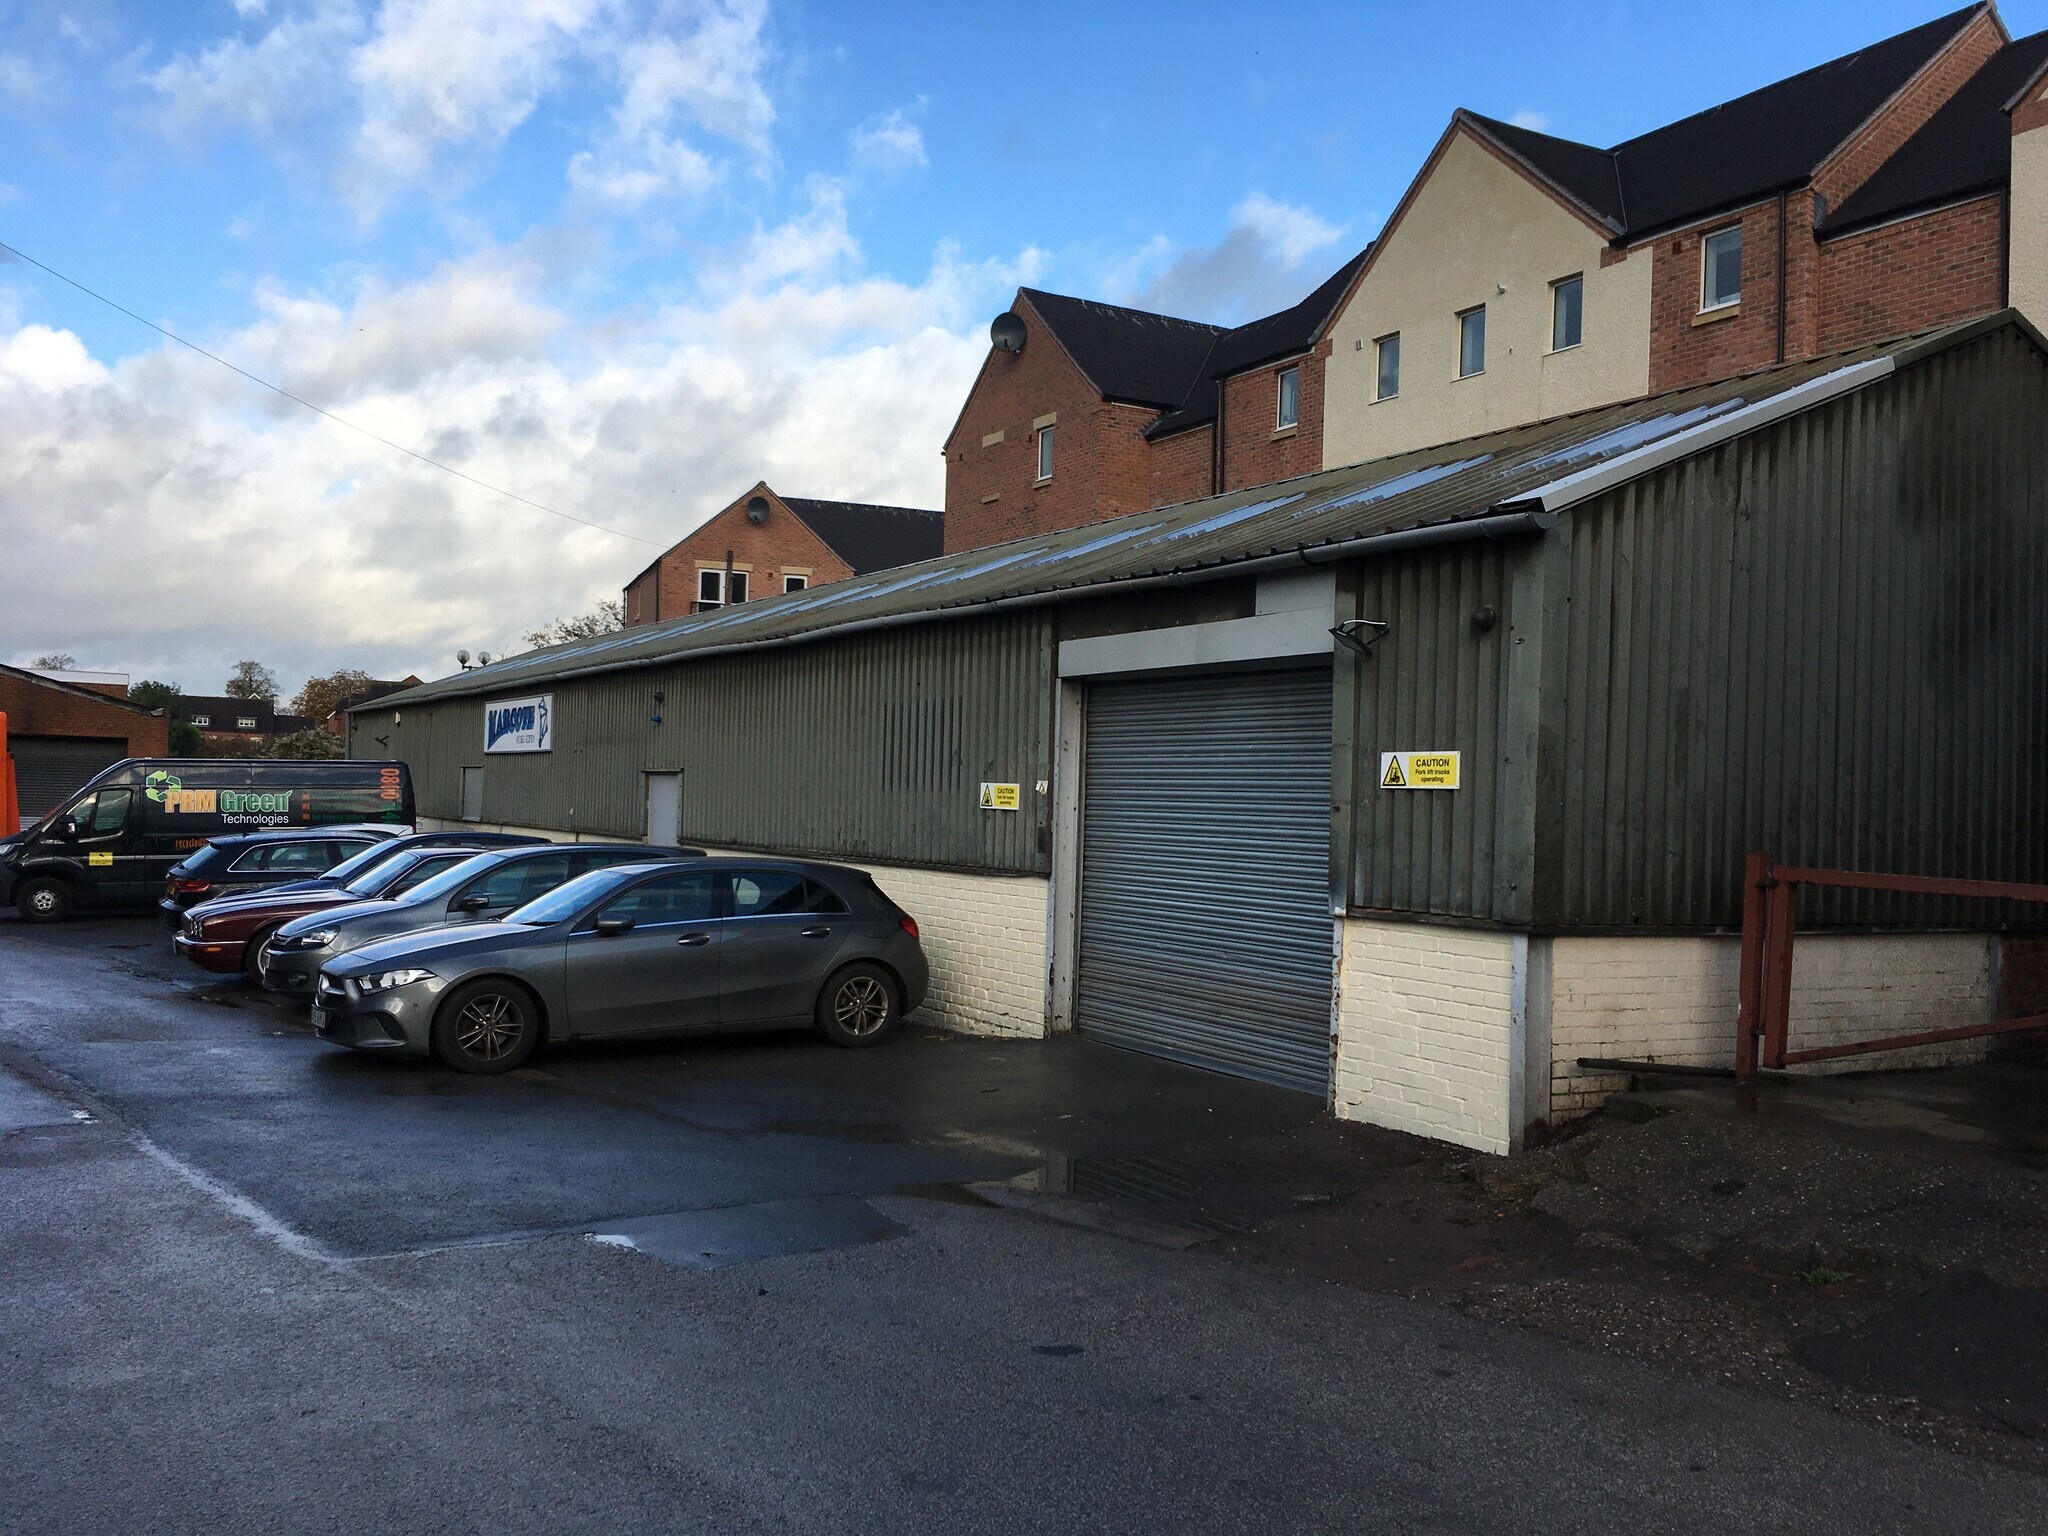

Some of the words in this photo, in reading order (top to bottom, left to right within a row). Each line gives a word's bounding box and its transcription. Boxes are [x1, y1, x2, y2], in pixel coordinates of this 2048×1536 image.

[1415, 758, 1450, 767] CAUTION
[165, 789, 217, 813] PRM
[220, 789, 293, 813] Green
[221, 813, 289, 826] Technologies
